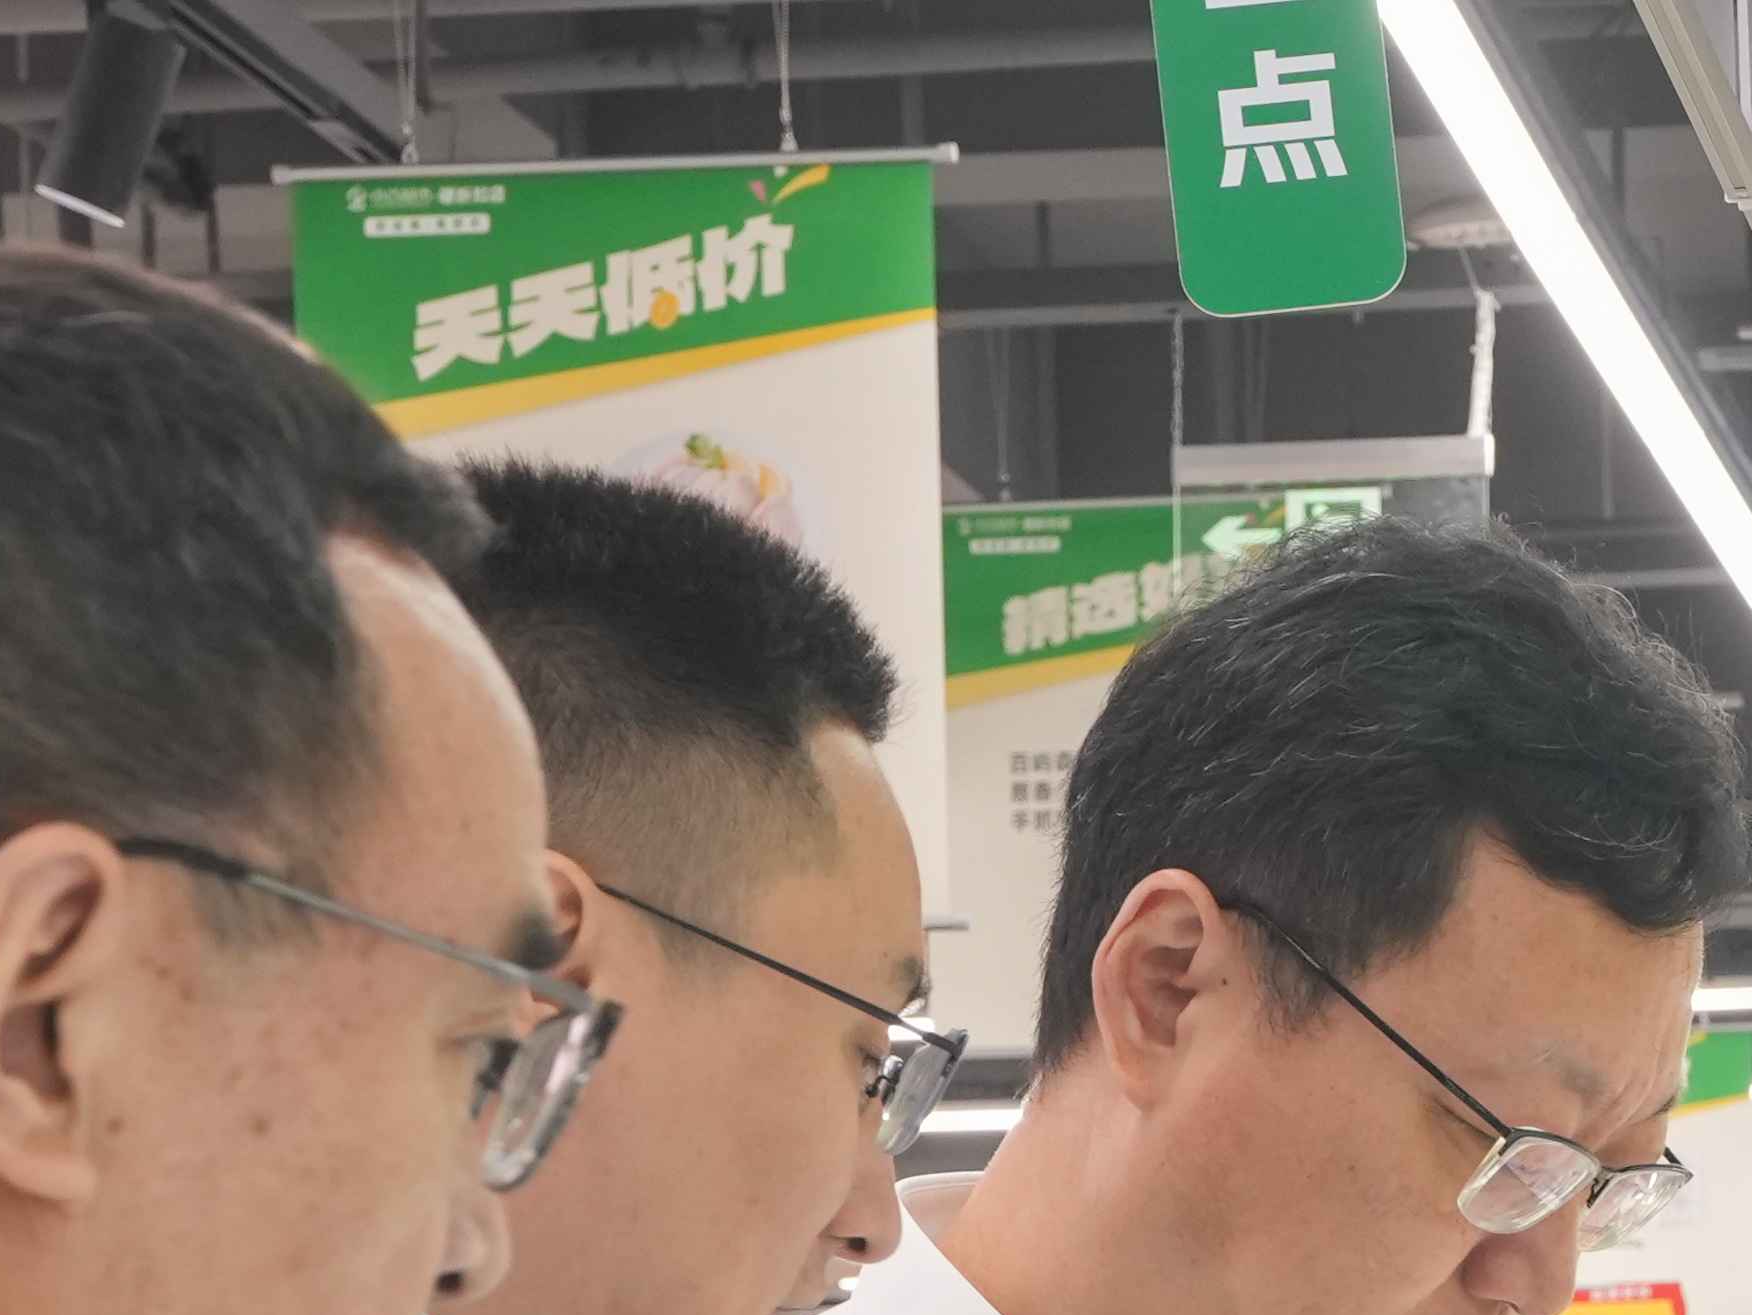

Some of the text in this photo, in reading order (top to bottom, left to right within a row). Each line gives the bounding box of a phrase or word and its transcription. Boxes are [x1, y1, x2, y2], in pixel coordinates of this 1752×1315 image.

[410, 213, 796, 383] 天天低价
[1002, 552, 1248, 655] 精选好
